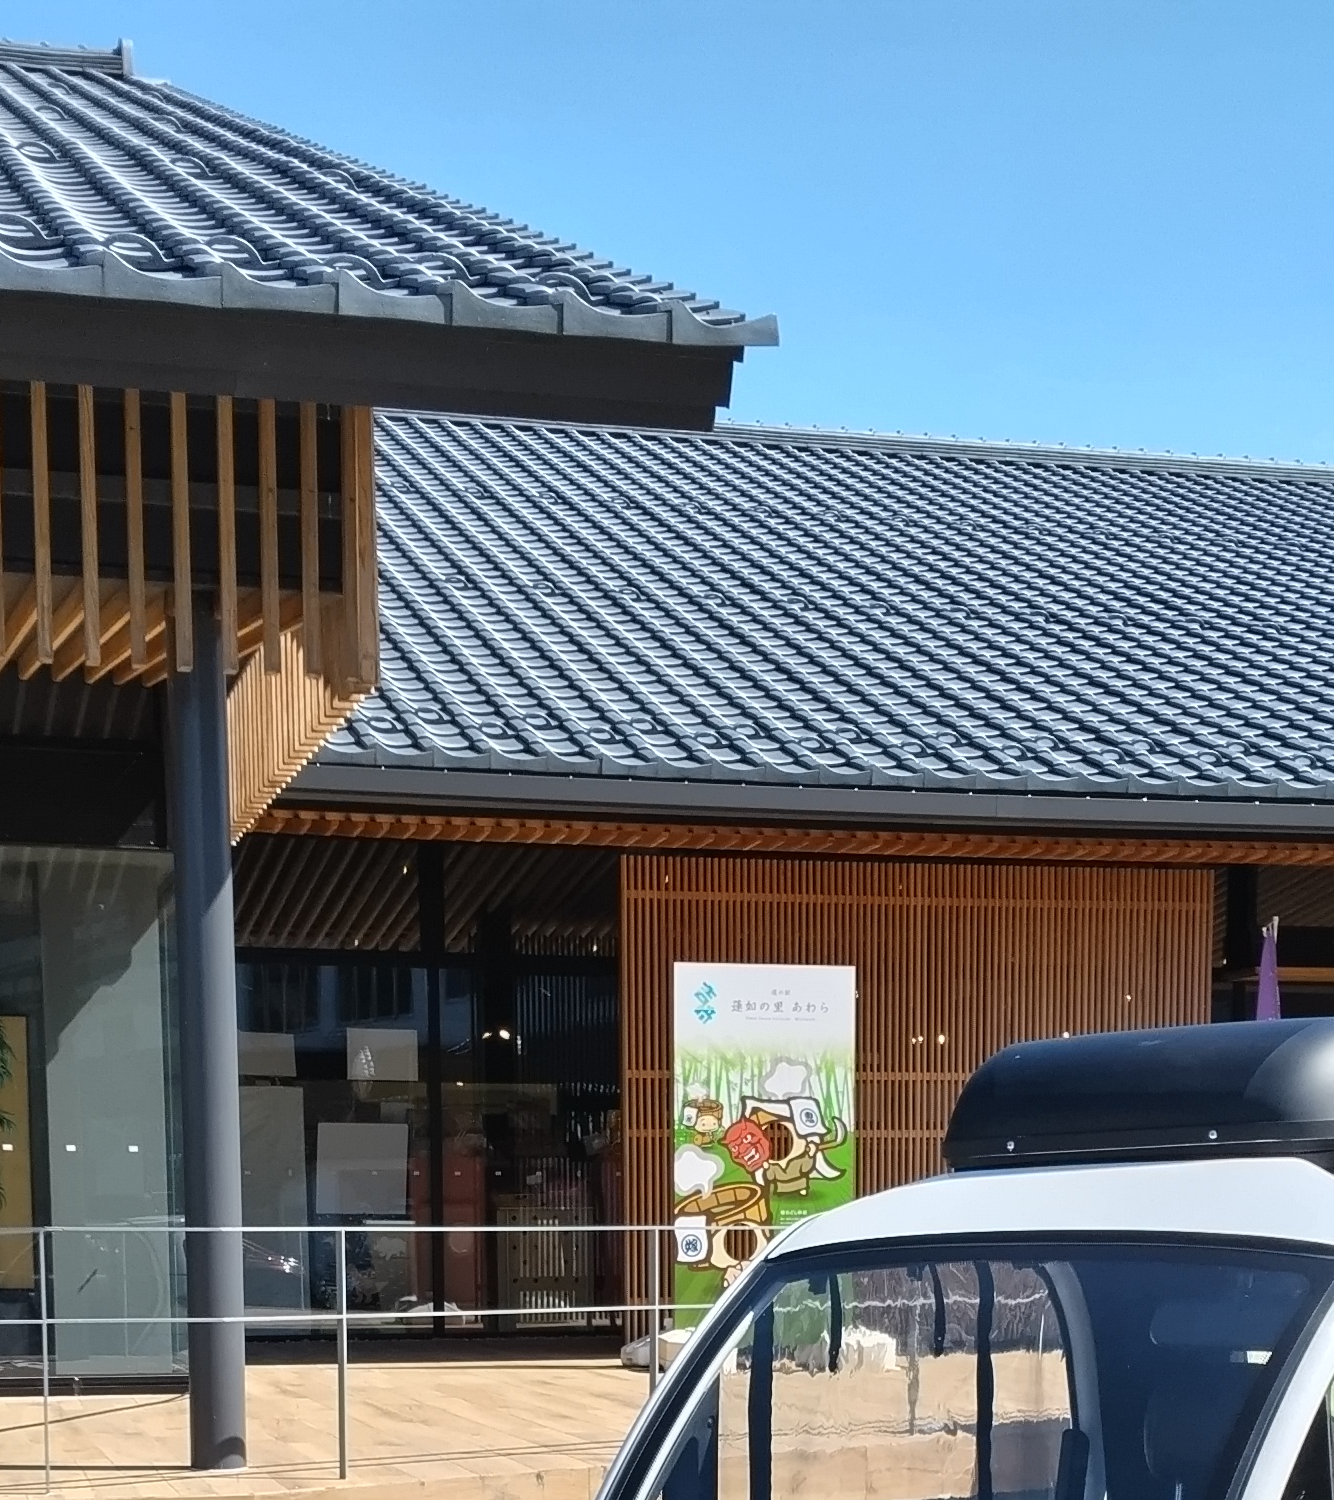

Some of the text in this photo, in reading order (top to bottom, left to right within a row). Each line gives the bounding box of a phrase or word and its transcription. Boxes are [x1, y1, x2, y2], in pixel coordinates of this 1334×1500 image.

[731, 999, 829, 1013] 蓮如の里 あわら
